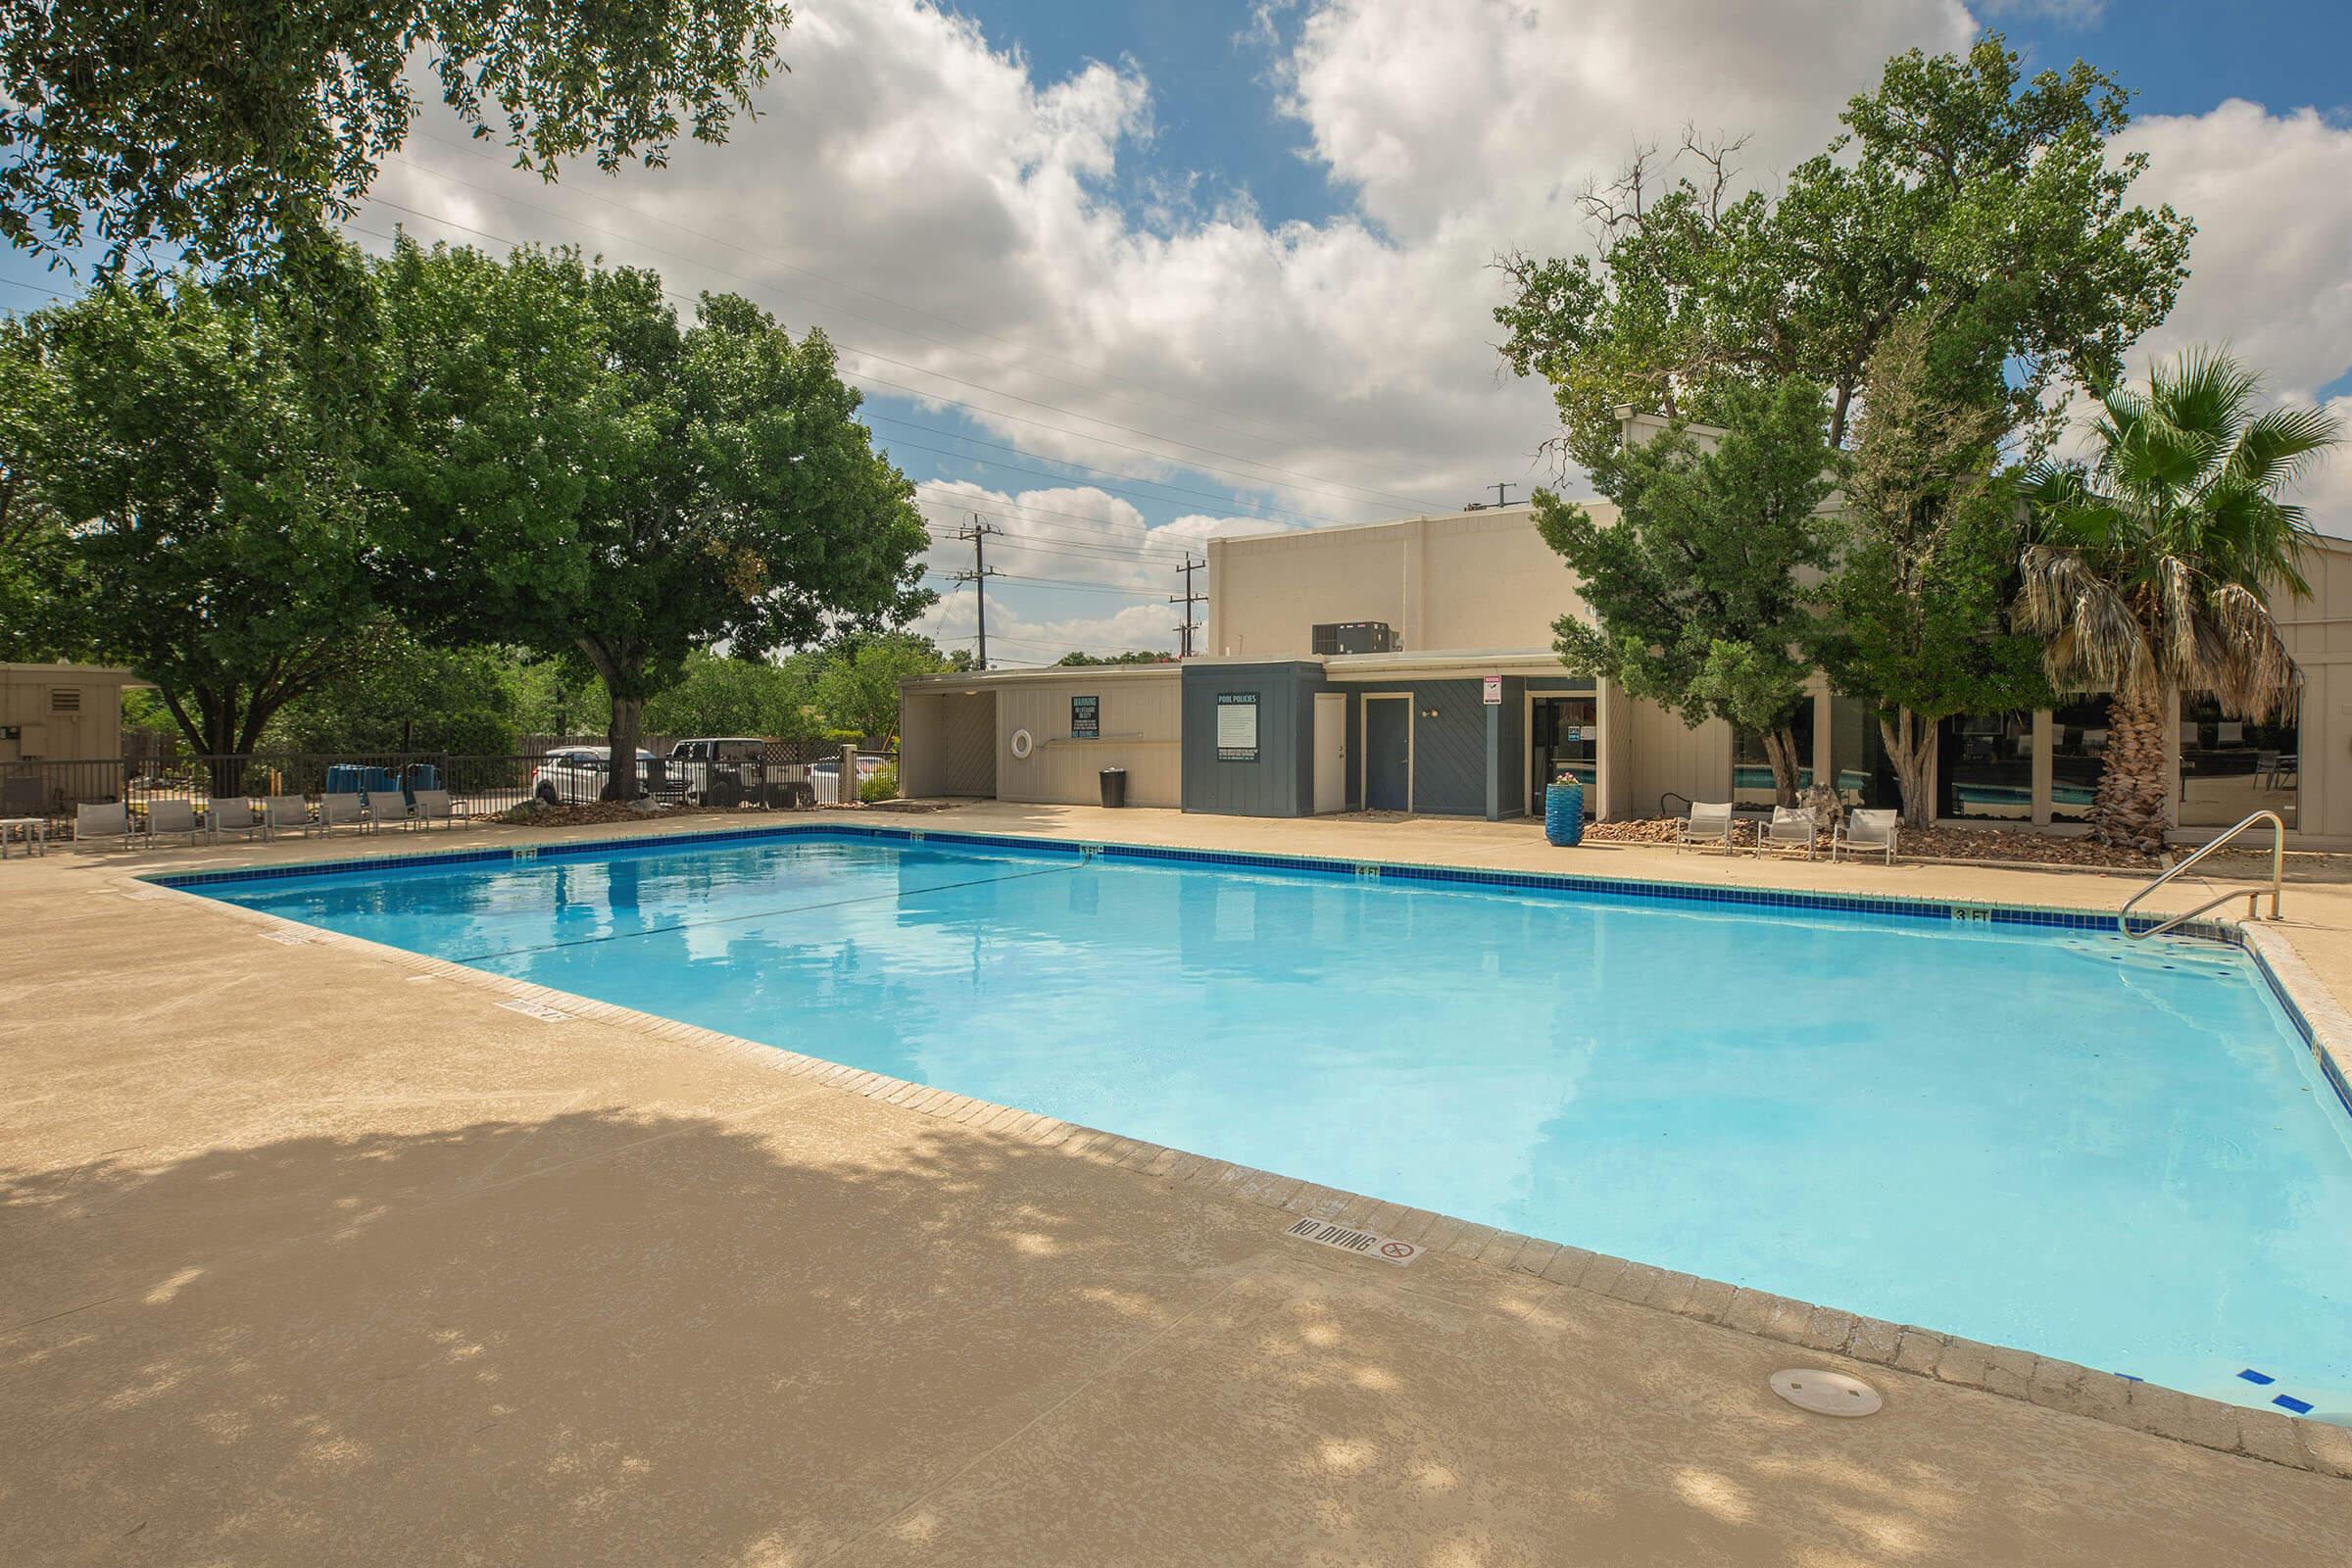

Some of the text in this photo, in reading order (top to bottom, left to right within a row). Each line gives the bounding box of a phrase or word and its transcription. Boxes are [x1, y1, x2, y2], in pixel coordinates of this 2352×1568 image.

[1218, 695, 1256, 704] POOL POLICIES
[1368, 867, 1379, 876] FT
[1956, 909, 1988, 921] 3 FT
[1288, 1219, 1377, 1251] NO DIVING
